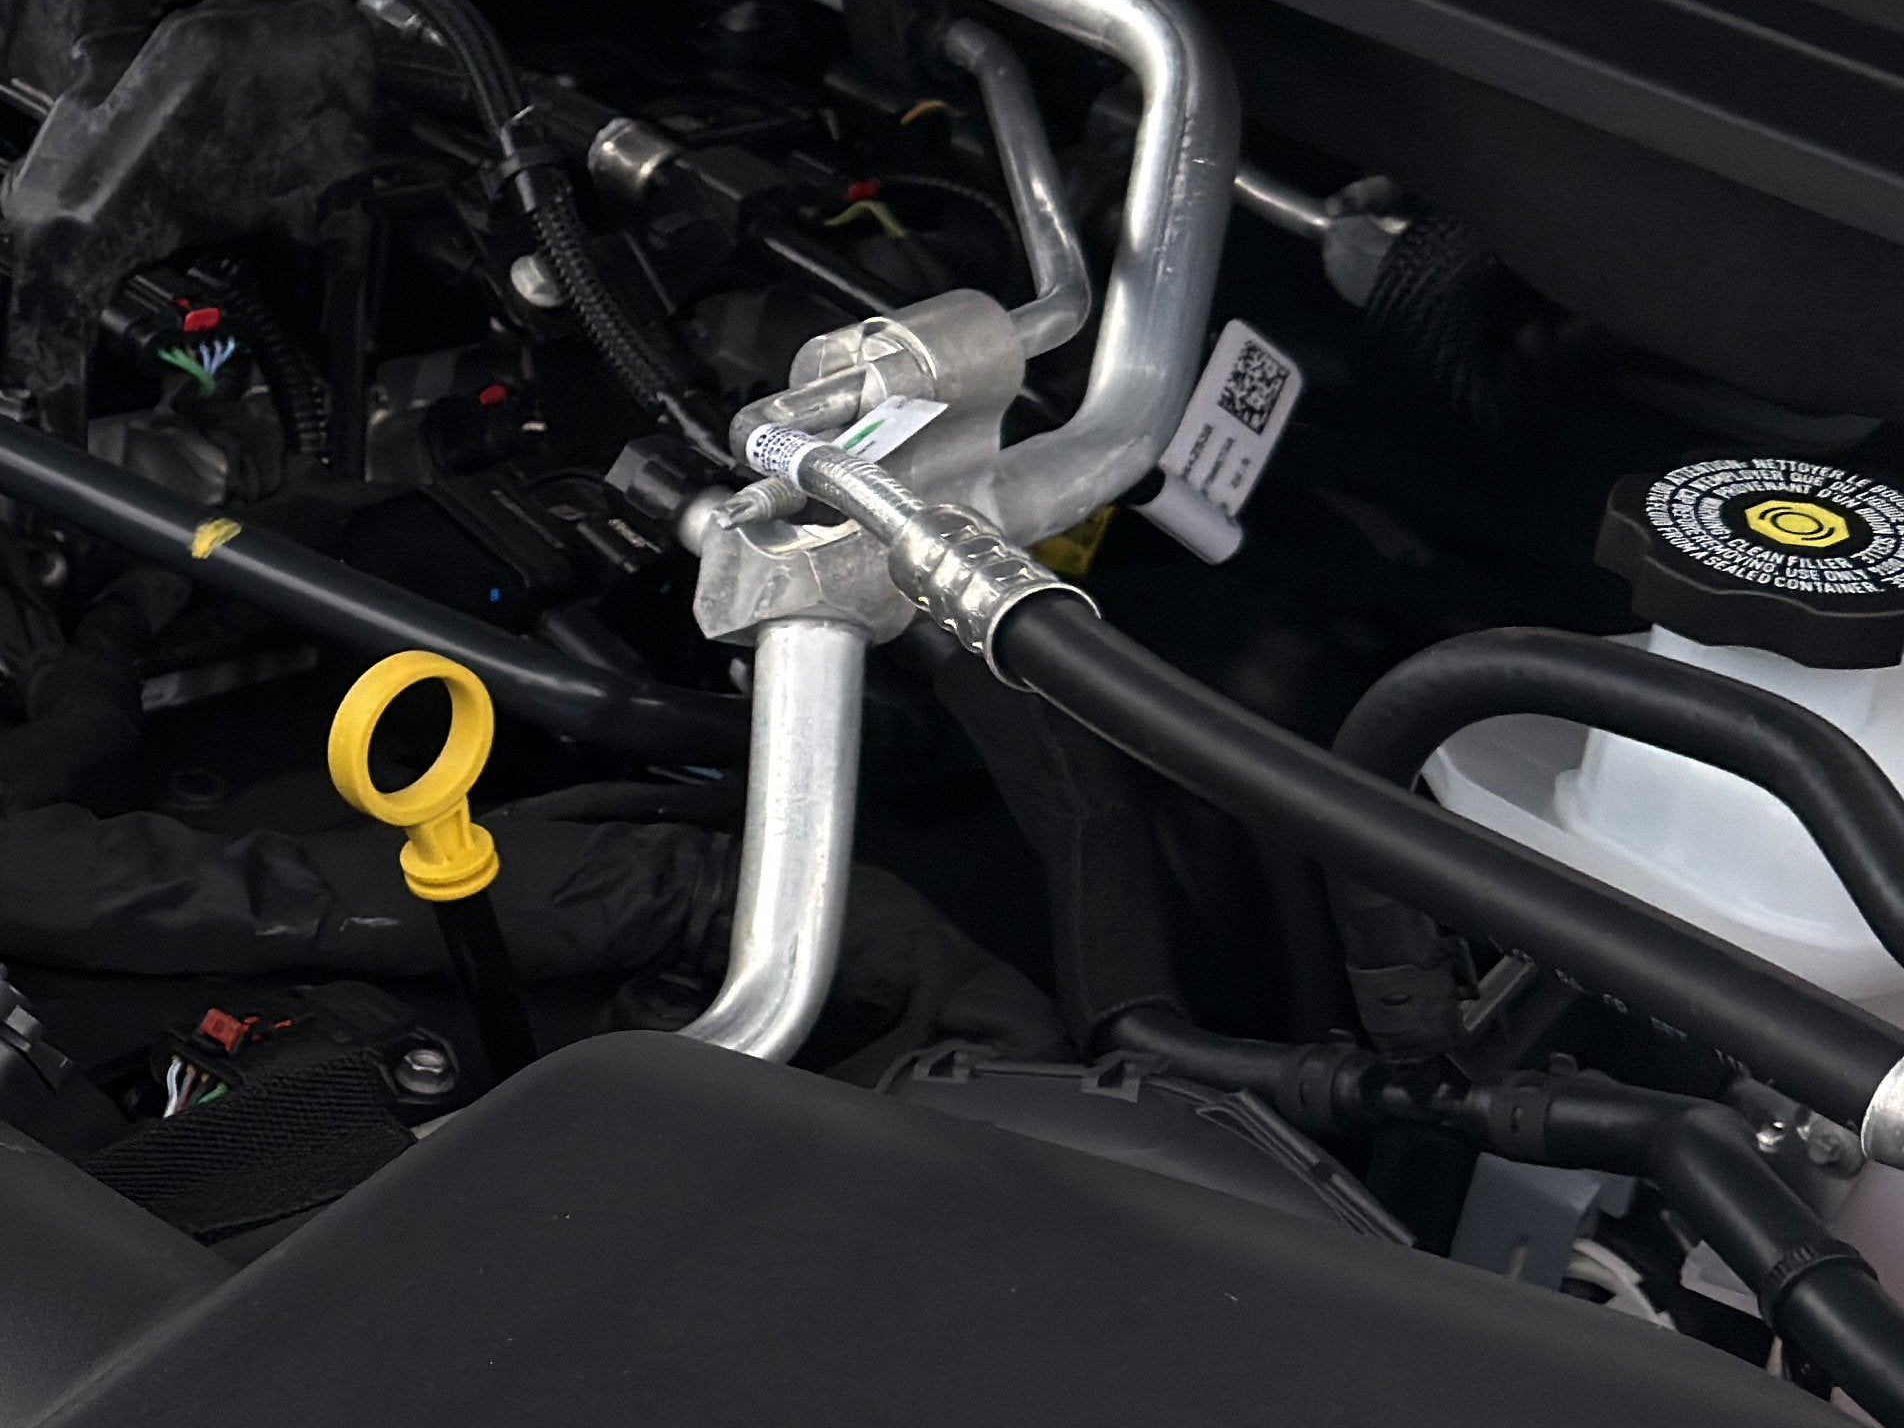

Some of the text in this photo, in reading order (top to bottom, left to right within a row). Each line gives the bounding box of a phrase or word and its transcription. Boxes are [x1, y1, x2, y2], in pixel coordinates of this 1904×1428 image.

[1751, 458, 1846, 480] NETTOYER
[1846, 474, 1873, 489] LE
[1789, 472, 1825, 487] QUE
[1829, 480, 1857, 494] DU
[1656, 527, 1700, 553] FROM
[1703, 556, 1772, 585] SEALED
[1727, 538, 1785, 565] CLEAN
[1787, 555, 1853, 570] FILLER
[1784, 567, 1821, 581] USE
[1823, 568, 1870, 581] ONLY
